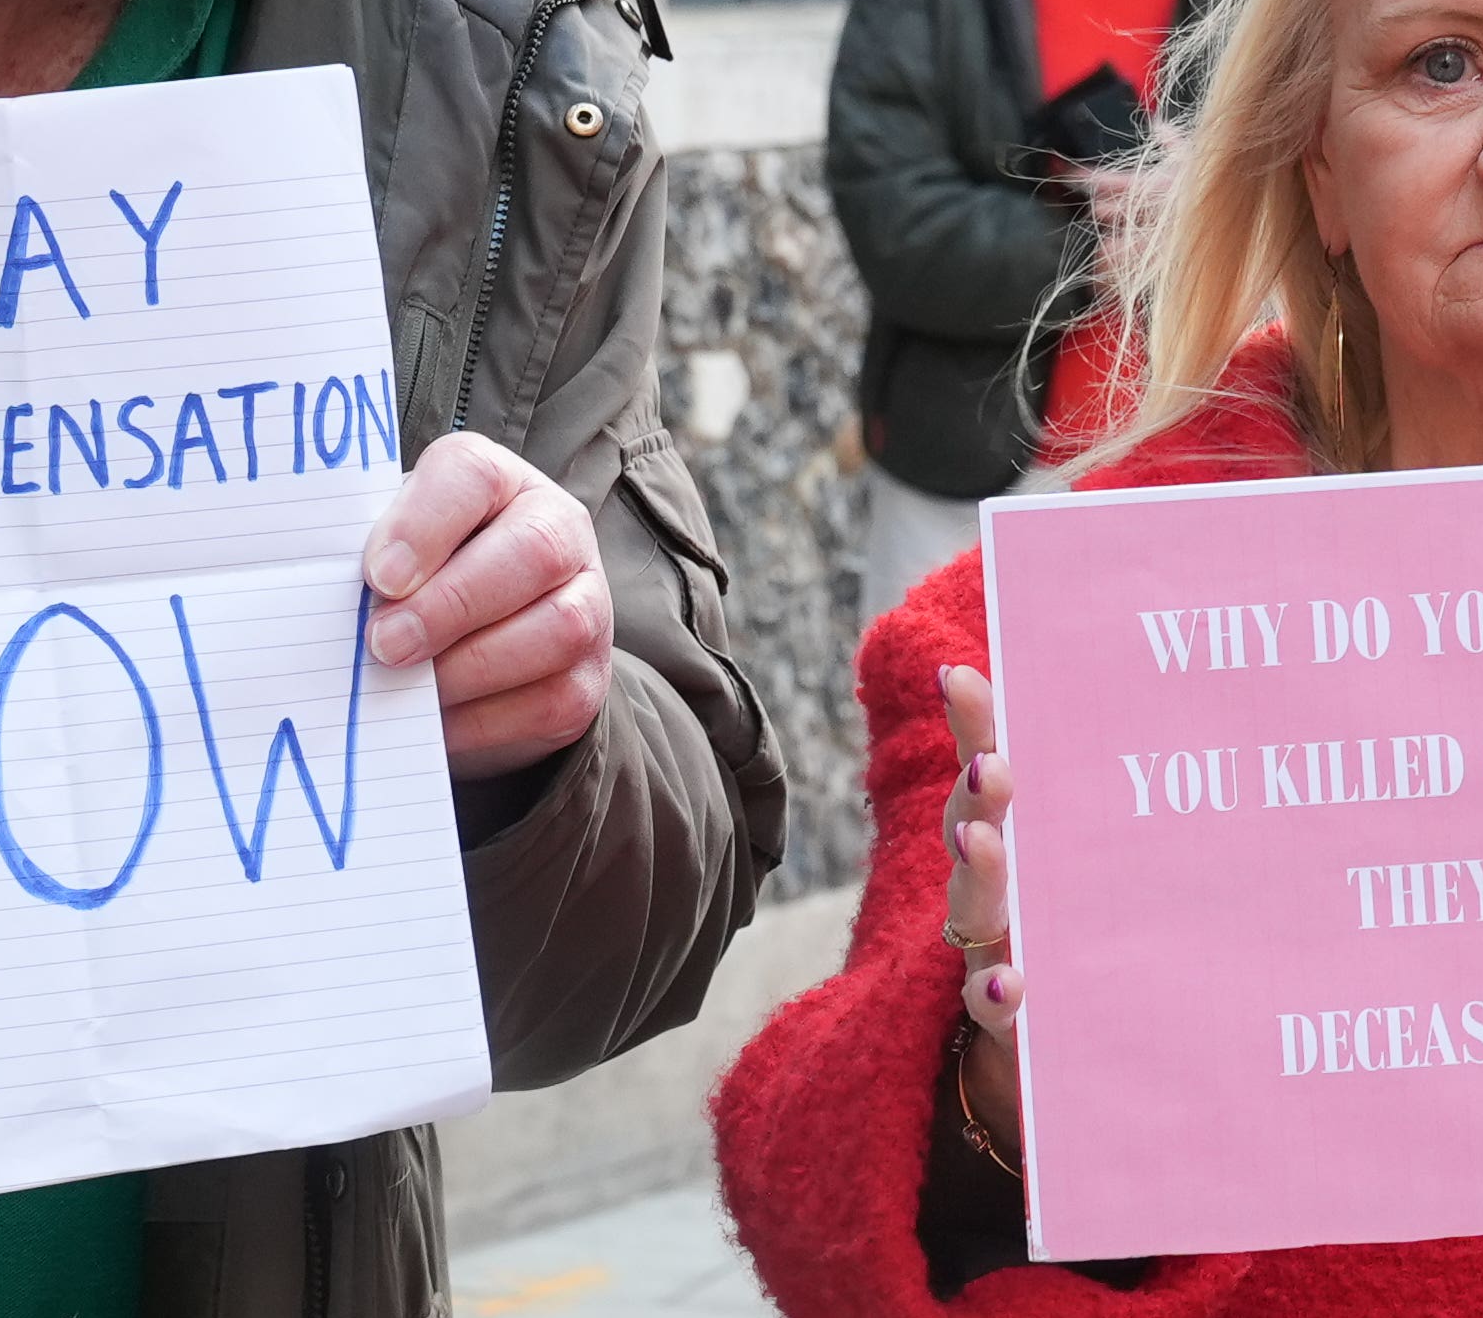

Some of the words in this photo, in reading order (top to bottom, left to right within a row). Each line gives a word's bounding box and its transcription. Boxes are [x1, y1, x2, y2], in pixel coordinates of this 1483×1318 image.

[1137, 603, 1288, 673] WHY
[1308, 597, 1390, 662] DO
[1119, 748, 1237, 816] YOU
[1259, 735, 1464, 807] KILLED
